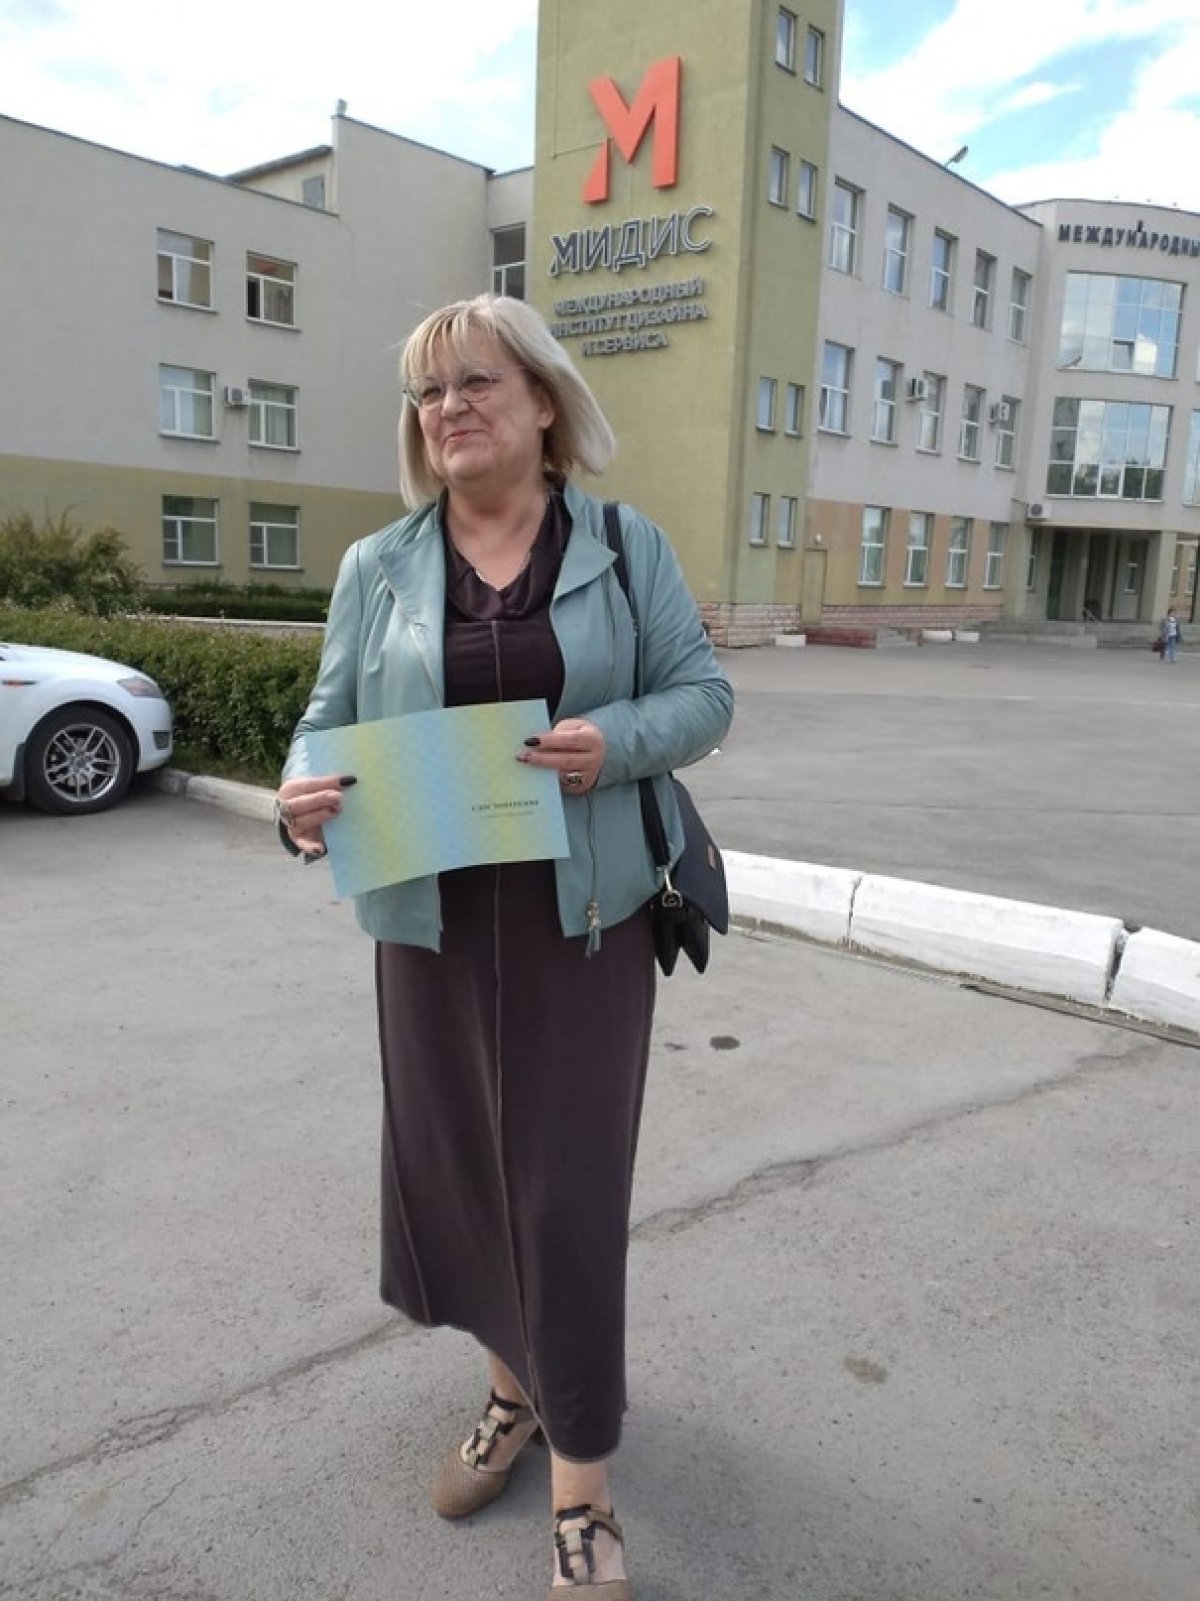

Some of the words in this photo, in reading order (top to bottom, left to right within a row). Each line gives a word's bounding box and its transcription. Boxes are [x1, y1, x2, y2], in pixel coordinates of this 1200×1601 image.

[549, 206, 714, 276] МИДИС
[555, 278, 705, 316] МЕЖДУНАРОДНЫЙ
[626, 302, 709, 332] ДИЗАЙНА
[594, 331, 668, 355] СЕРВИСА
